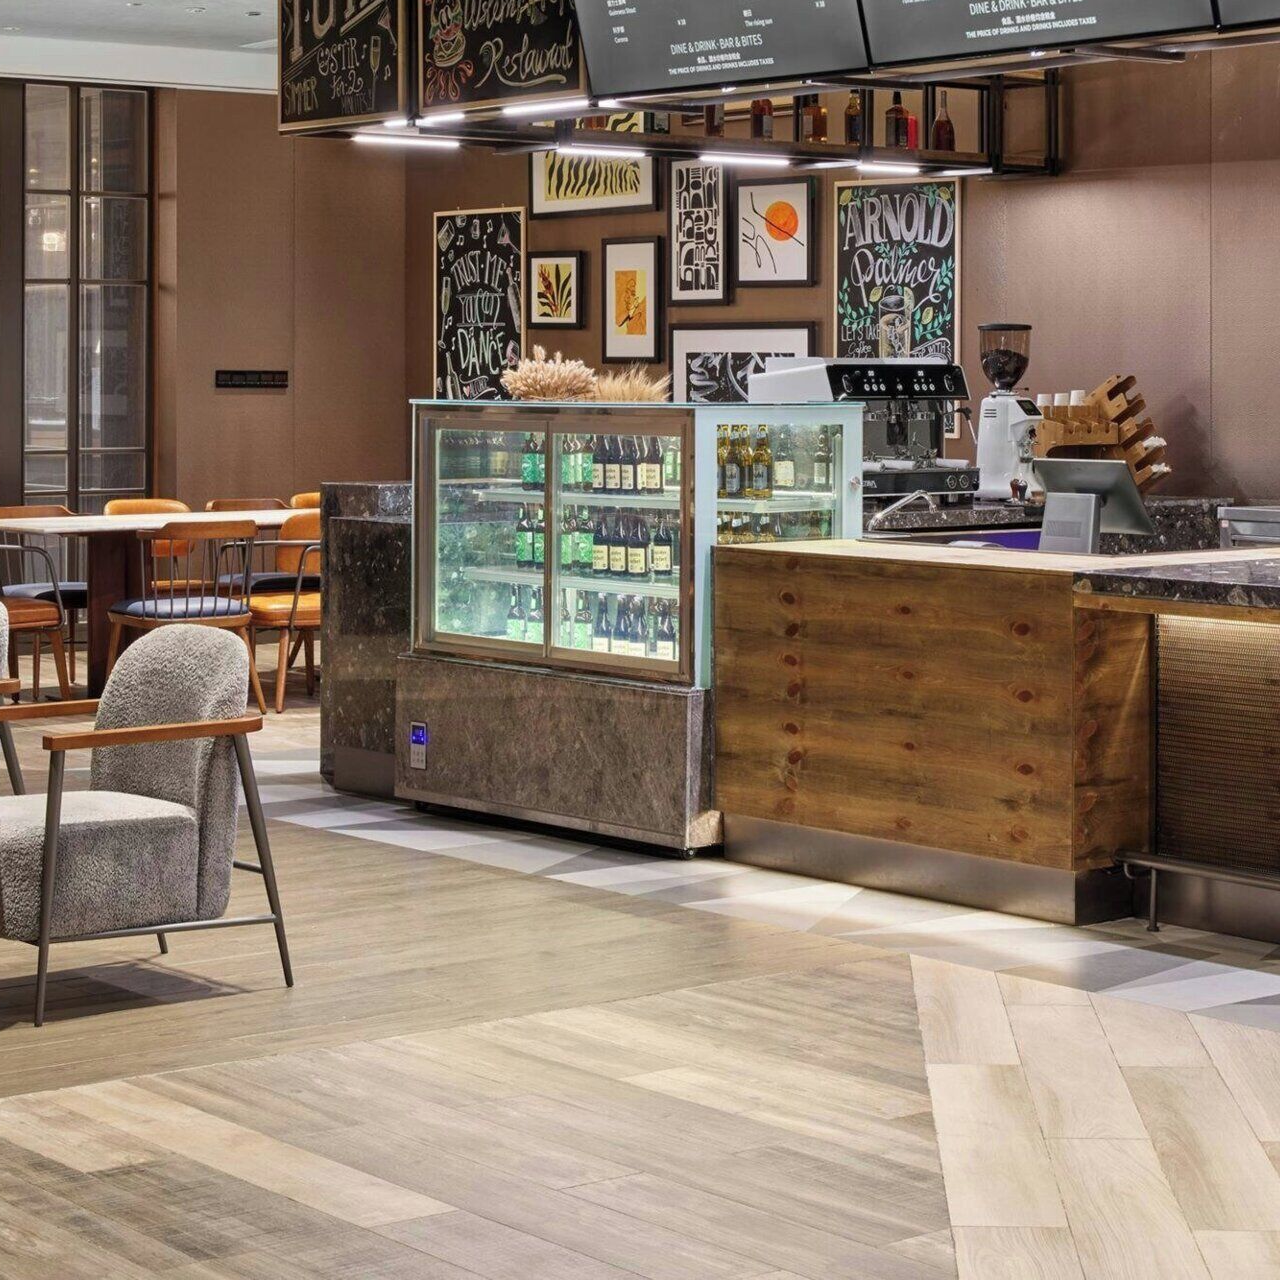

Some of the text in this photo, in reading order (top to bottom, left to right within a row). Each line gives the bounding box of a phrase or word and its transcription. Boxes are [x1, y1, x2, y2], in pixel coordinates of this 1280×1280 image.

[969, 1, 990, 15] DINE
[991, 0, 998, 12] &
[976, 29, 992, 37] PRICE
[999, 25, 1019, 34] DRINKS
[1020, 24, 1031, 32] AND
[670, 42, 688, 54] DINE
[688, 42, 694, 53] &
[734, 36, 741, 47] &
[741, 33, 762, 46] BITES
[843, 193, 954, 250] ARNOLD
[457, 329, 508, 377] DANCE
